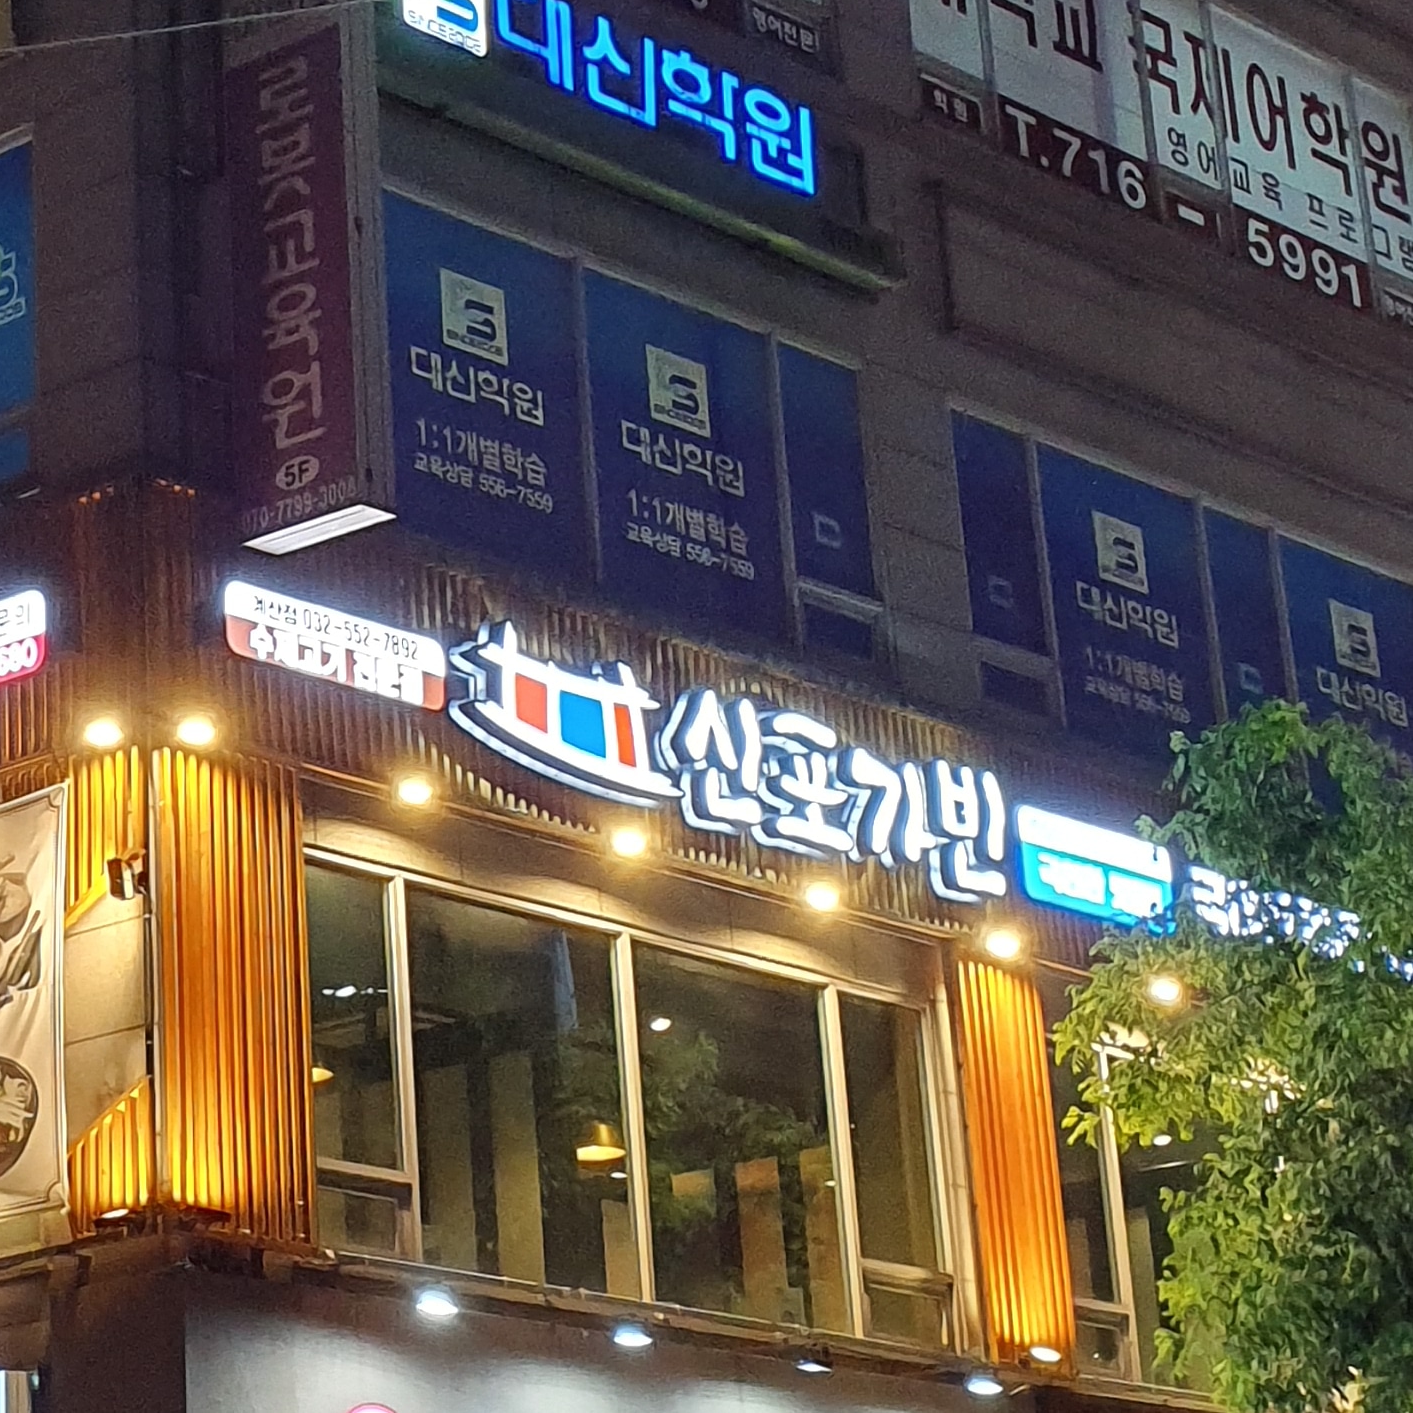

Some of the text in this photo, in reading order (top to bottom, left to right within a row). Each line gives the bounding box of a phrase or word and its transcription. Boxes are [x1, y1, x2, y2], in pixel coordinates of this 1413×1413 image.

[1128, 1, 1413, 224] 국제어학원
[410, 344, 544, 426] 대신학원
[282, 459, 312, 487] 5F
[414, 452, 553, 515] 교육상담 556-7559
[621, 419, 744, 497] 대신학원
[254, 596, 418, 660] 계산점 032-552-7892
[1076, 580, 1179, 649] 대신학원
[1316, 666, 1409, 727] 대신학원
[686, 689, 1007, 897] 신포가빈
